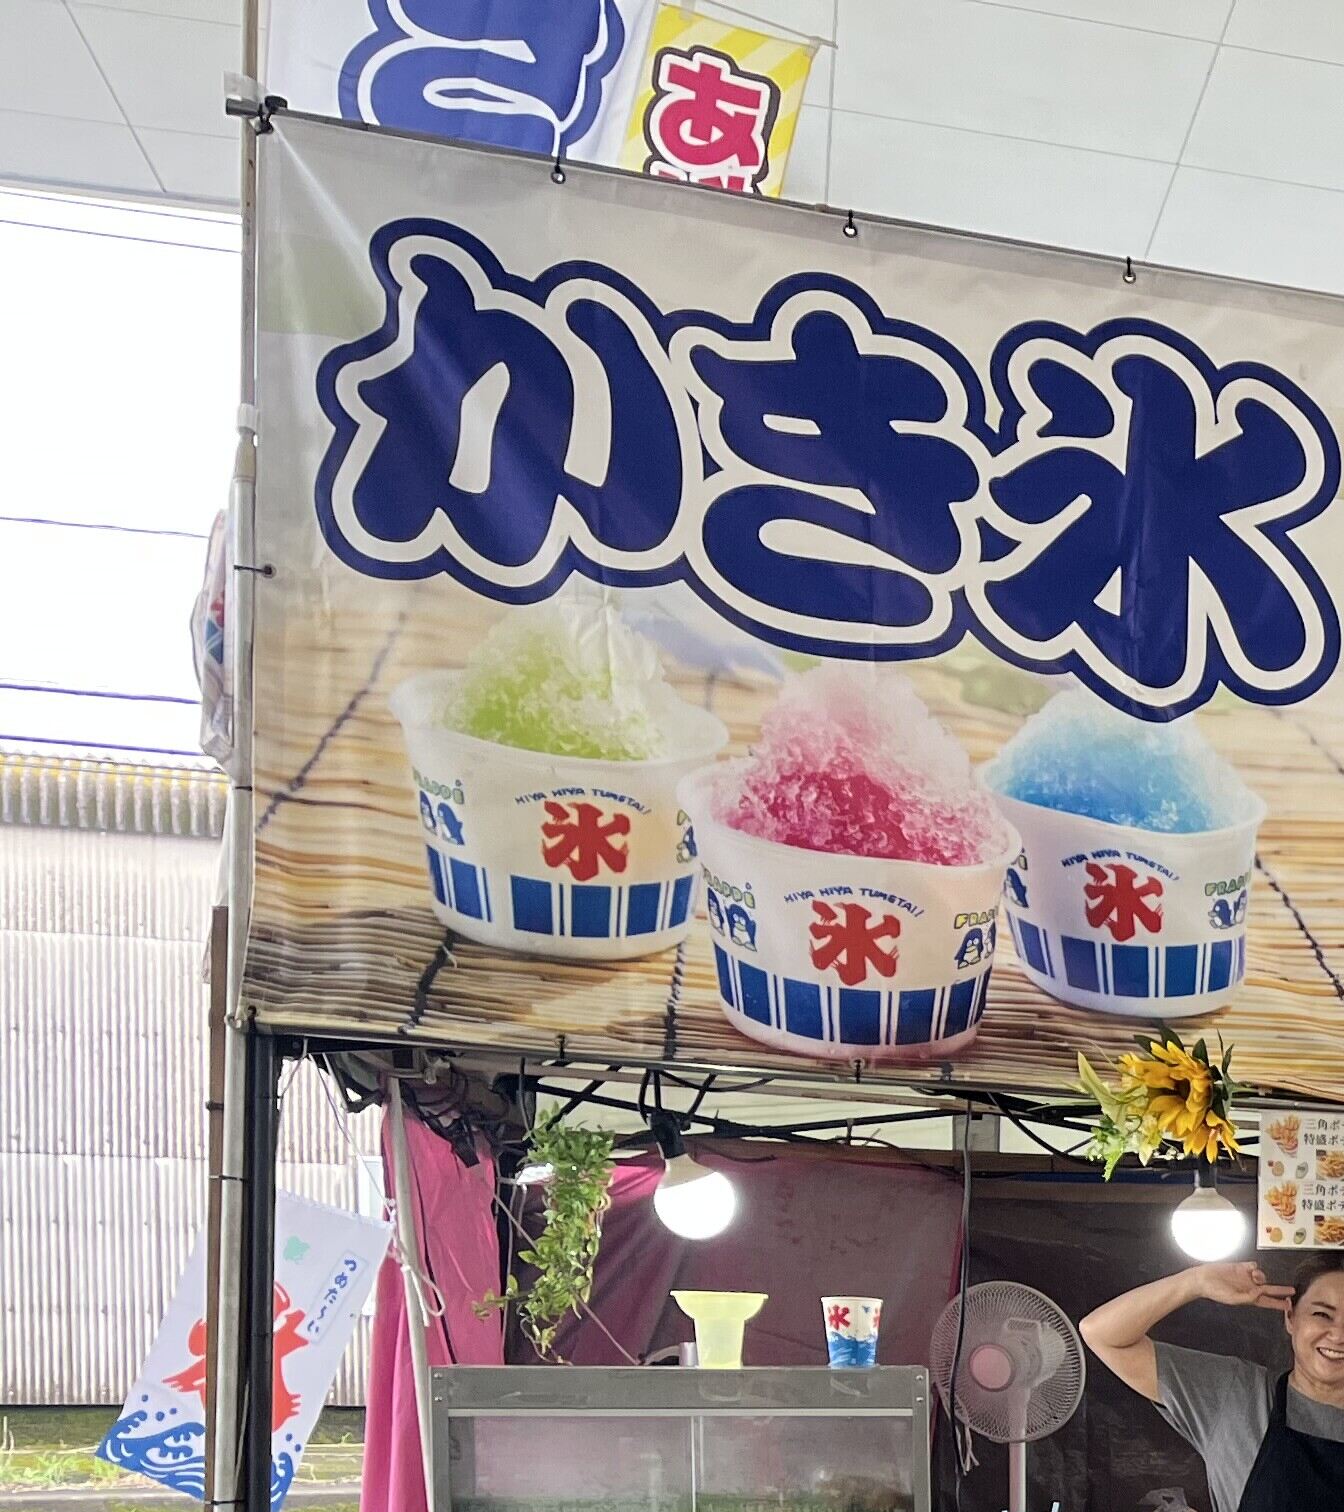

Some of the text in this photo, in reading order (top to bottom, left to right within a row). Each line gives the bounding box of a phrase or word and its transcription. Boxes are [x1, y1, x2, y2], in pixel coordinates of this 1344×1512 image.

[648, 46, 775, 195] あ
[315, 217, 1341, 722] かき氷
[542, 801, 630, 881] 氷
[809, 900, 901, 986] 氷
[1083, 862, 1165, 942] 氷
